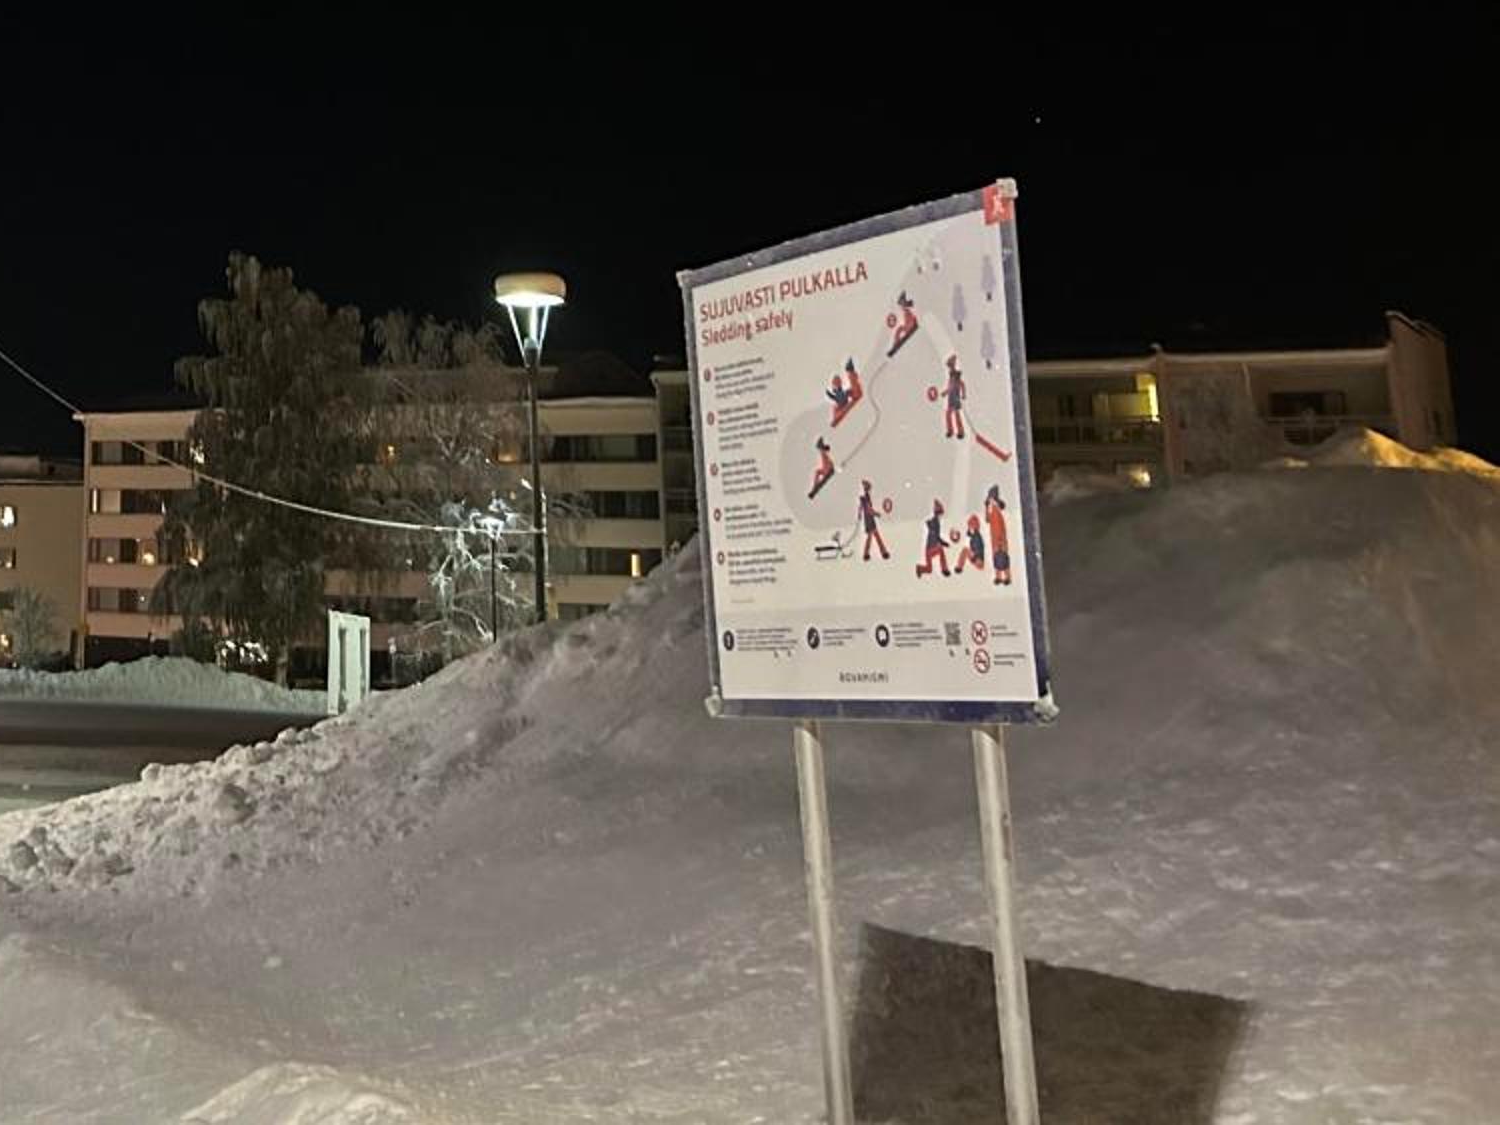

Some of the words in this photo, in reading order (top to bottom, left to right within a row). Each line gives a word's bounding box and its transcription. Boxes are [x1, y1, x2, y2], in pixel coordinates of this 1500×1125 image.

[700, 284, 776, 324] SUJUVASTI
[780, 261, 869, 302] PULKALLA
[701, 320, 752, 347] Sledding
[755, 309, 794, 332] safely
